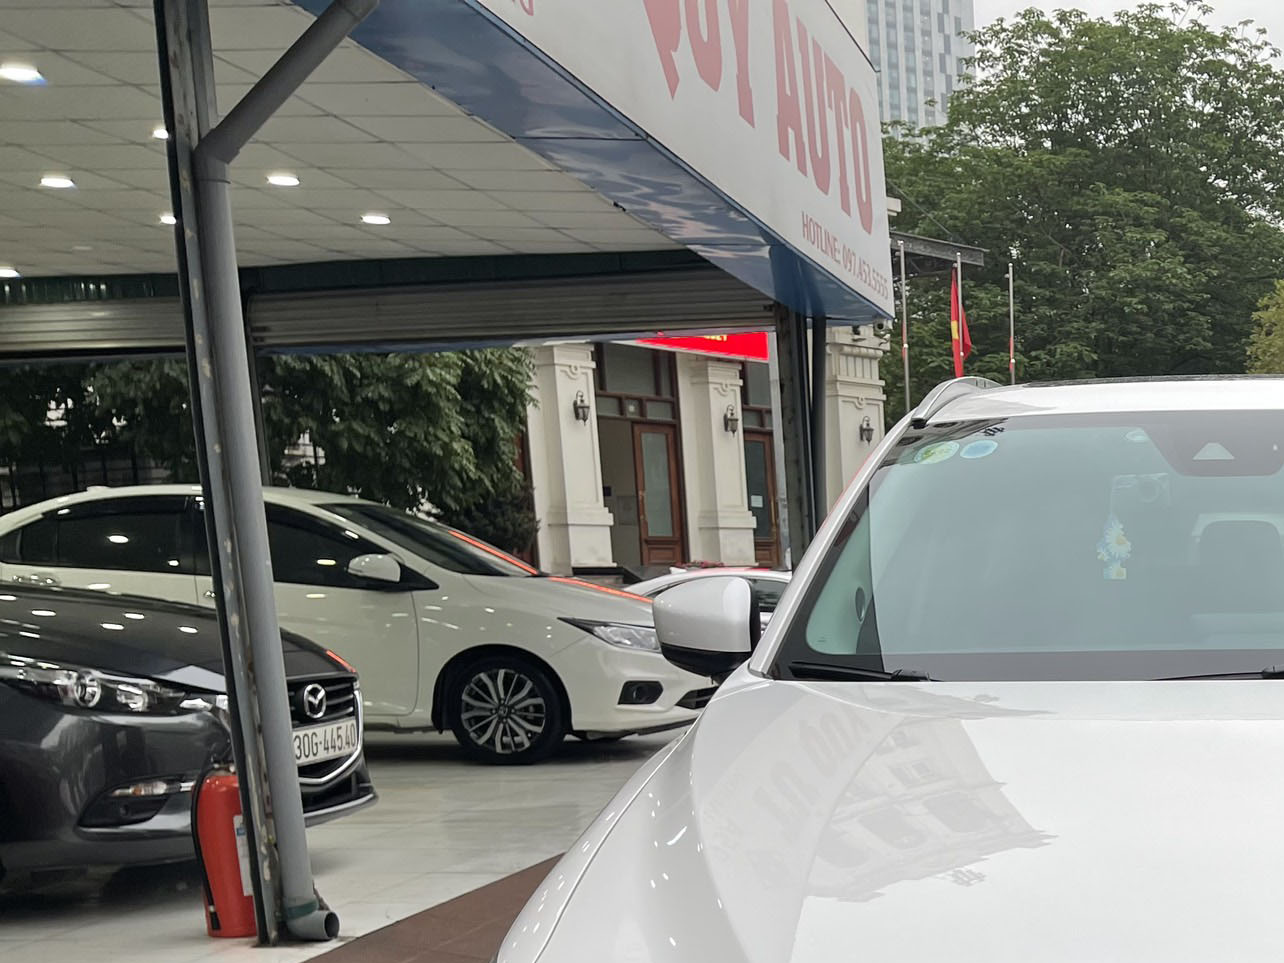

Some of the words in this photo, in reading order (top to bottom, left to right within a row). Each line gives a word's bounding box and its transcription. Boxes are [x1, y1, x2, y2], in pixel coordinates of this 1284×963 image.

[772, 0, 873, 236] AUTO
[801, 210, 841, 265] HOTLINE:
[293, 722, 356, 760] 30G-445.40
